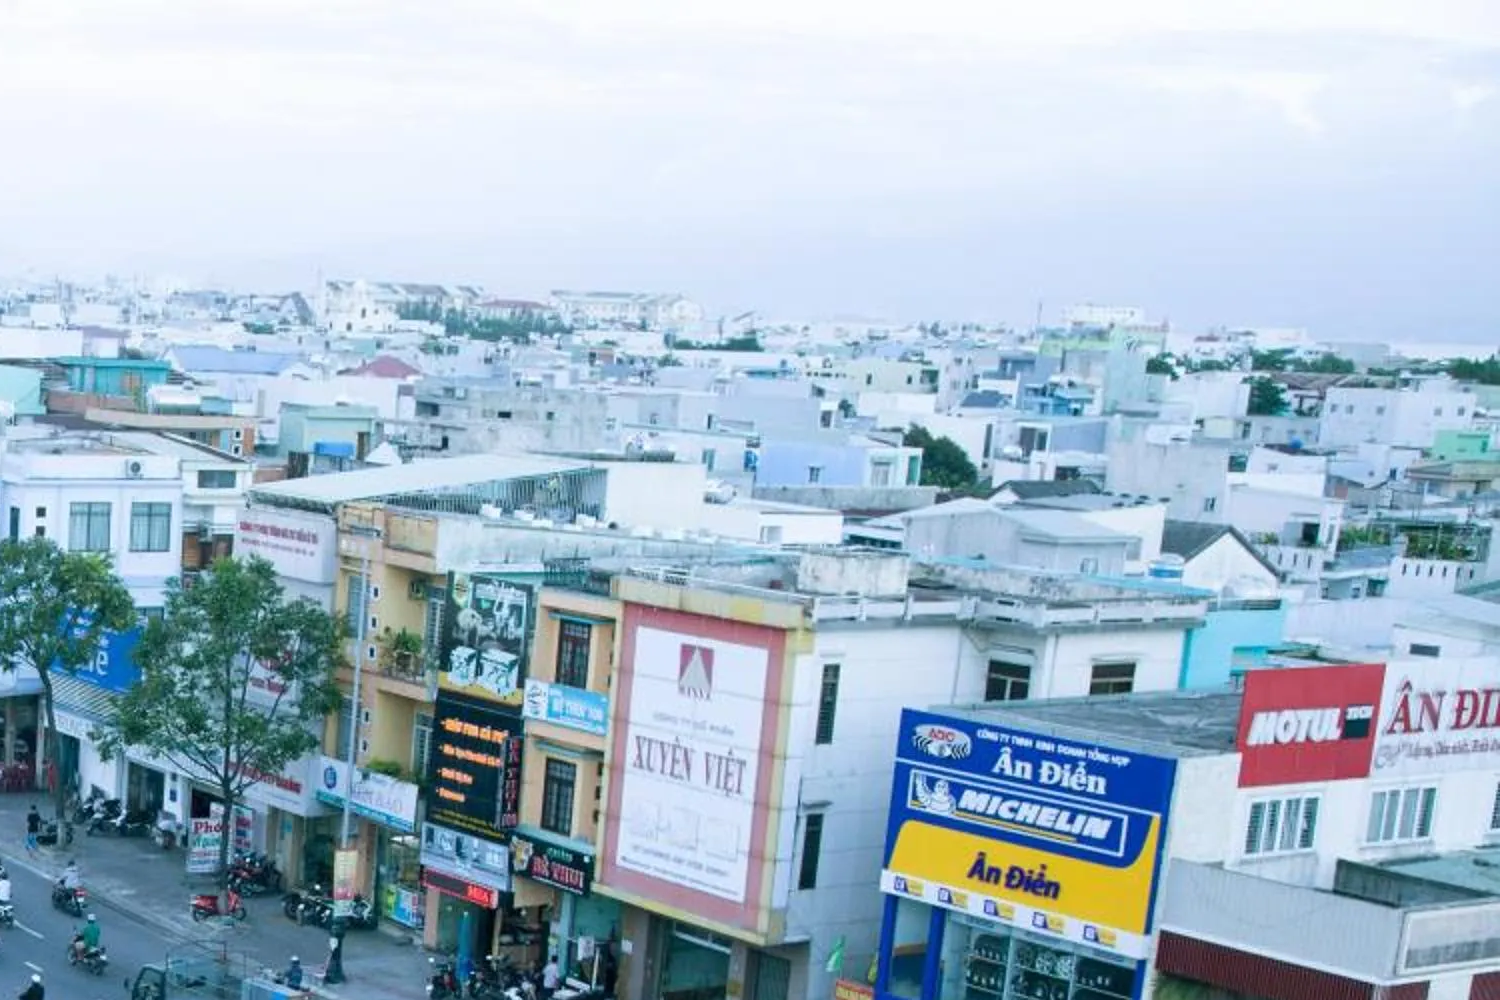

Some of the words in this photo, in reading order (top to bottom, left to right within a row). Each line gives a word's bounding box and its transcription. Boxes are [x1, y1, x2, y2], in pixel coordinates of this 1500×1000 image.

[1247, 707, 1343, 746] MOTUL
[1385, 679, 1447, 736] ÂN
[632, 735, 698, 782] XUYÊN
[705, 747, 747, 797] VIỆT
[992, 746, 1032, 780] Ân
[1038, 761, 1106, 795] Điển
[958, 789, 1113, 839] MICHELIN
[967, 851, 1002, 886] Ân
[1003, 863, 1061, 900] Điển
